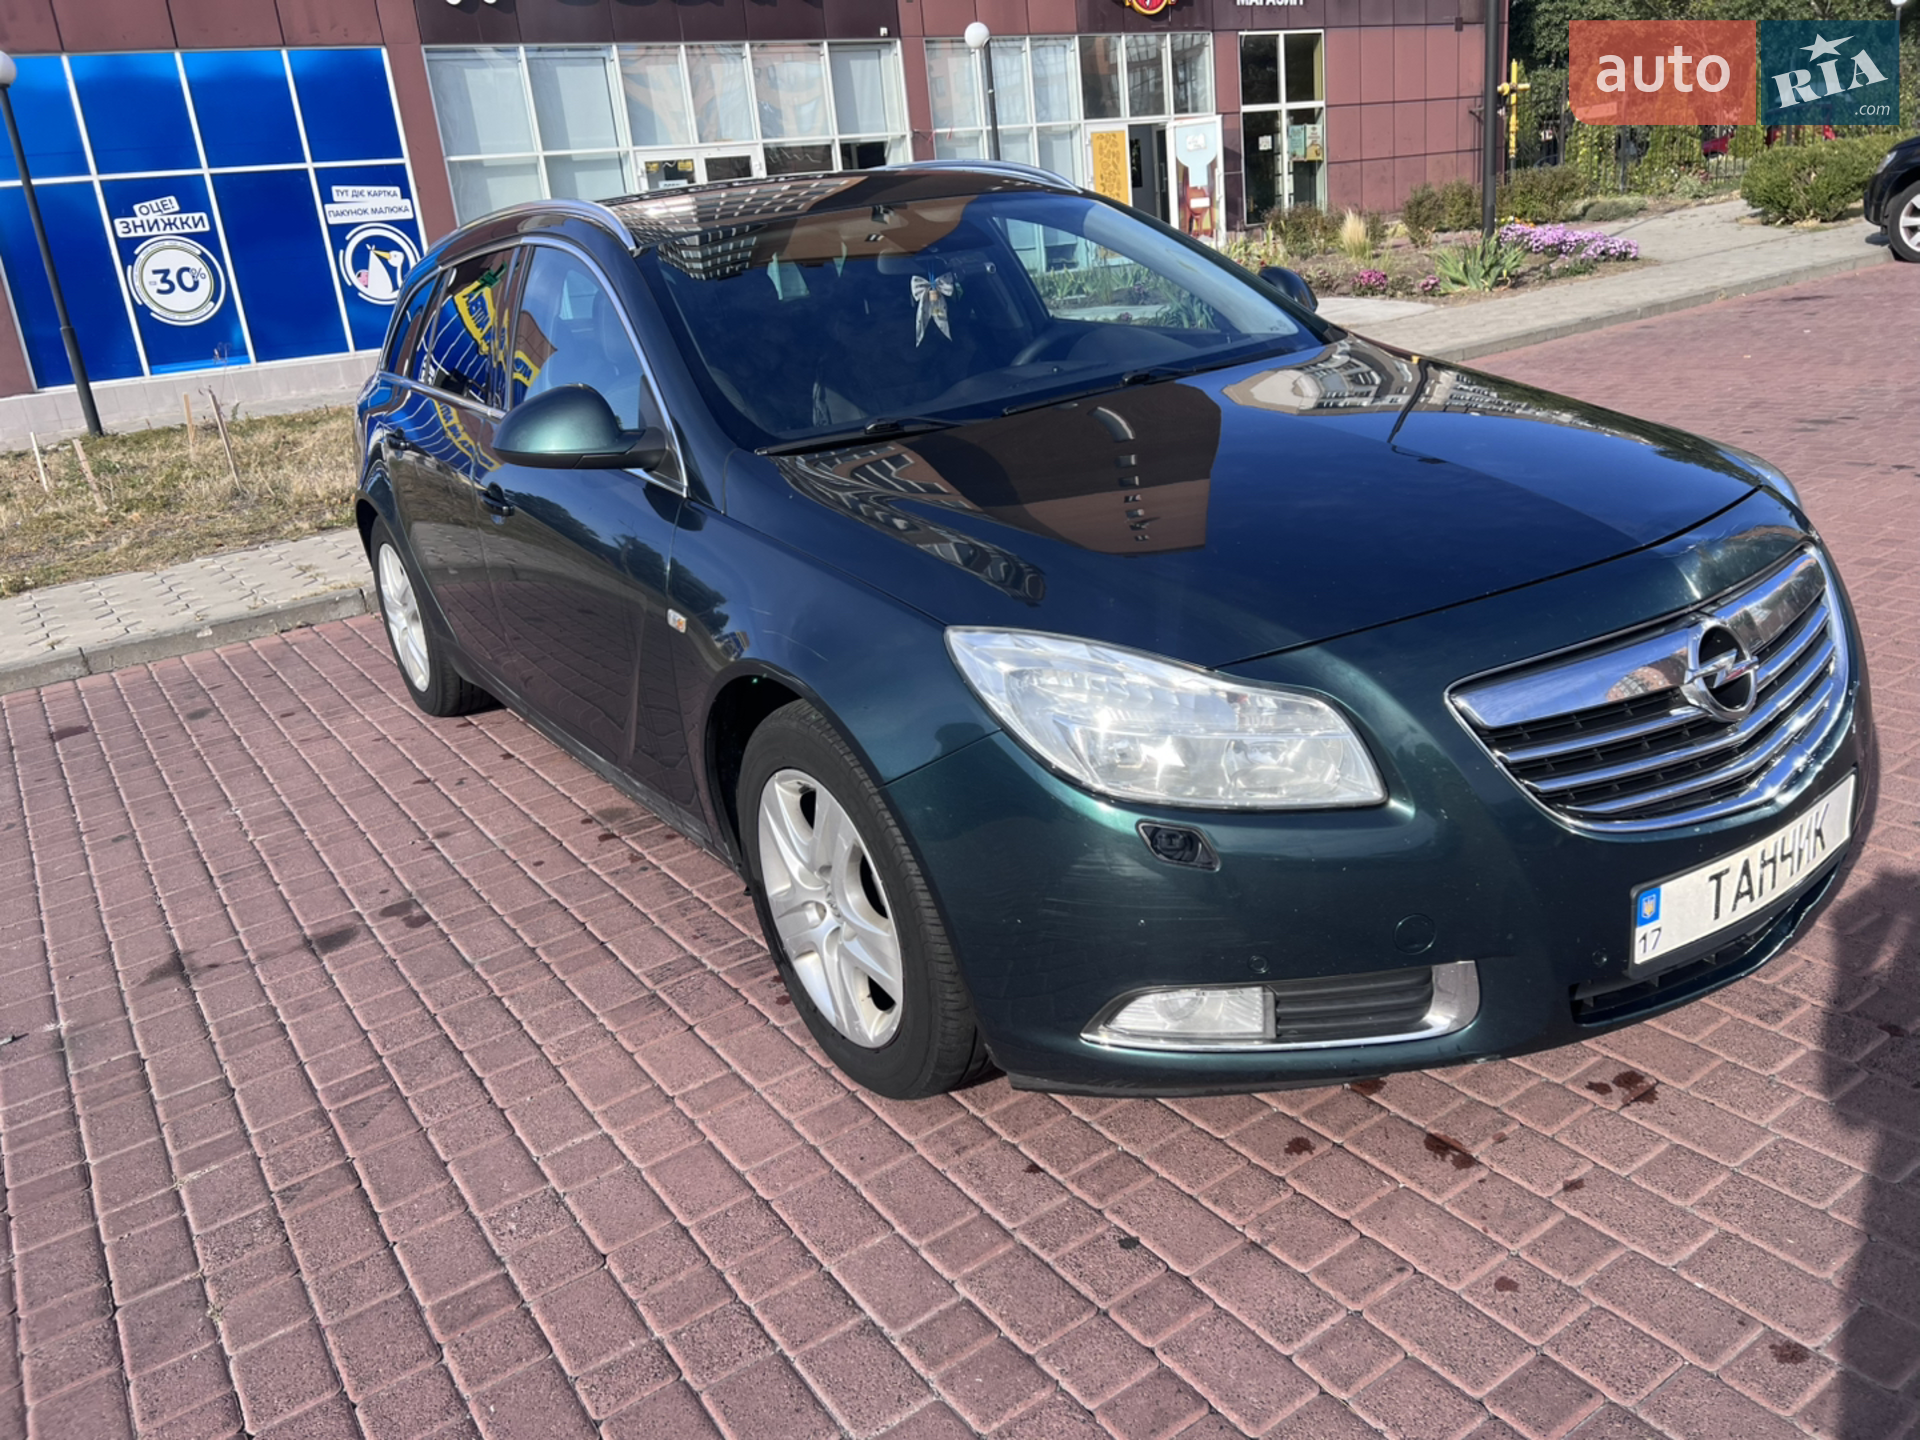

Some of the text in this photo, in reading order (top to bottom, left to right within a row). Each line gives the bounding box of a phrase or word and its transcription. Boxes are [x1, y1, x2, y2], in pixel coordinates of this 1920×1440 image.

[334, 188, 399, 198] ТУТ ДІЄ КАРТКА
[138, 198, 176, 216] ОЦЕ!
[328, 204, 410, 218] ПАКУНОК МАЛЮКА
[118, 215, 206, 235] ЗНИЖКИ
[1707, 802, 1830, 921] ТАНЧИК
[1638, 926, 1662, 954] 17
